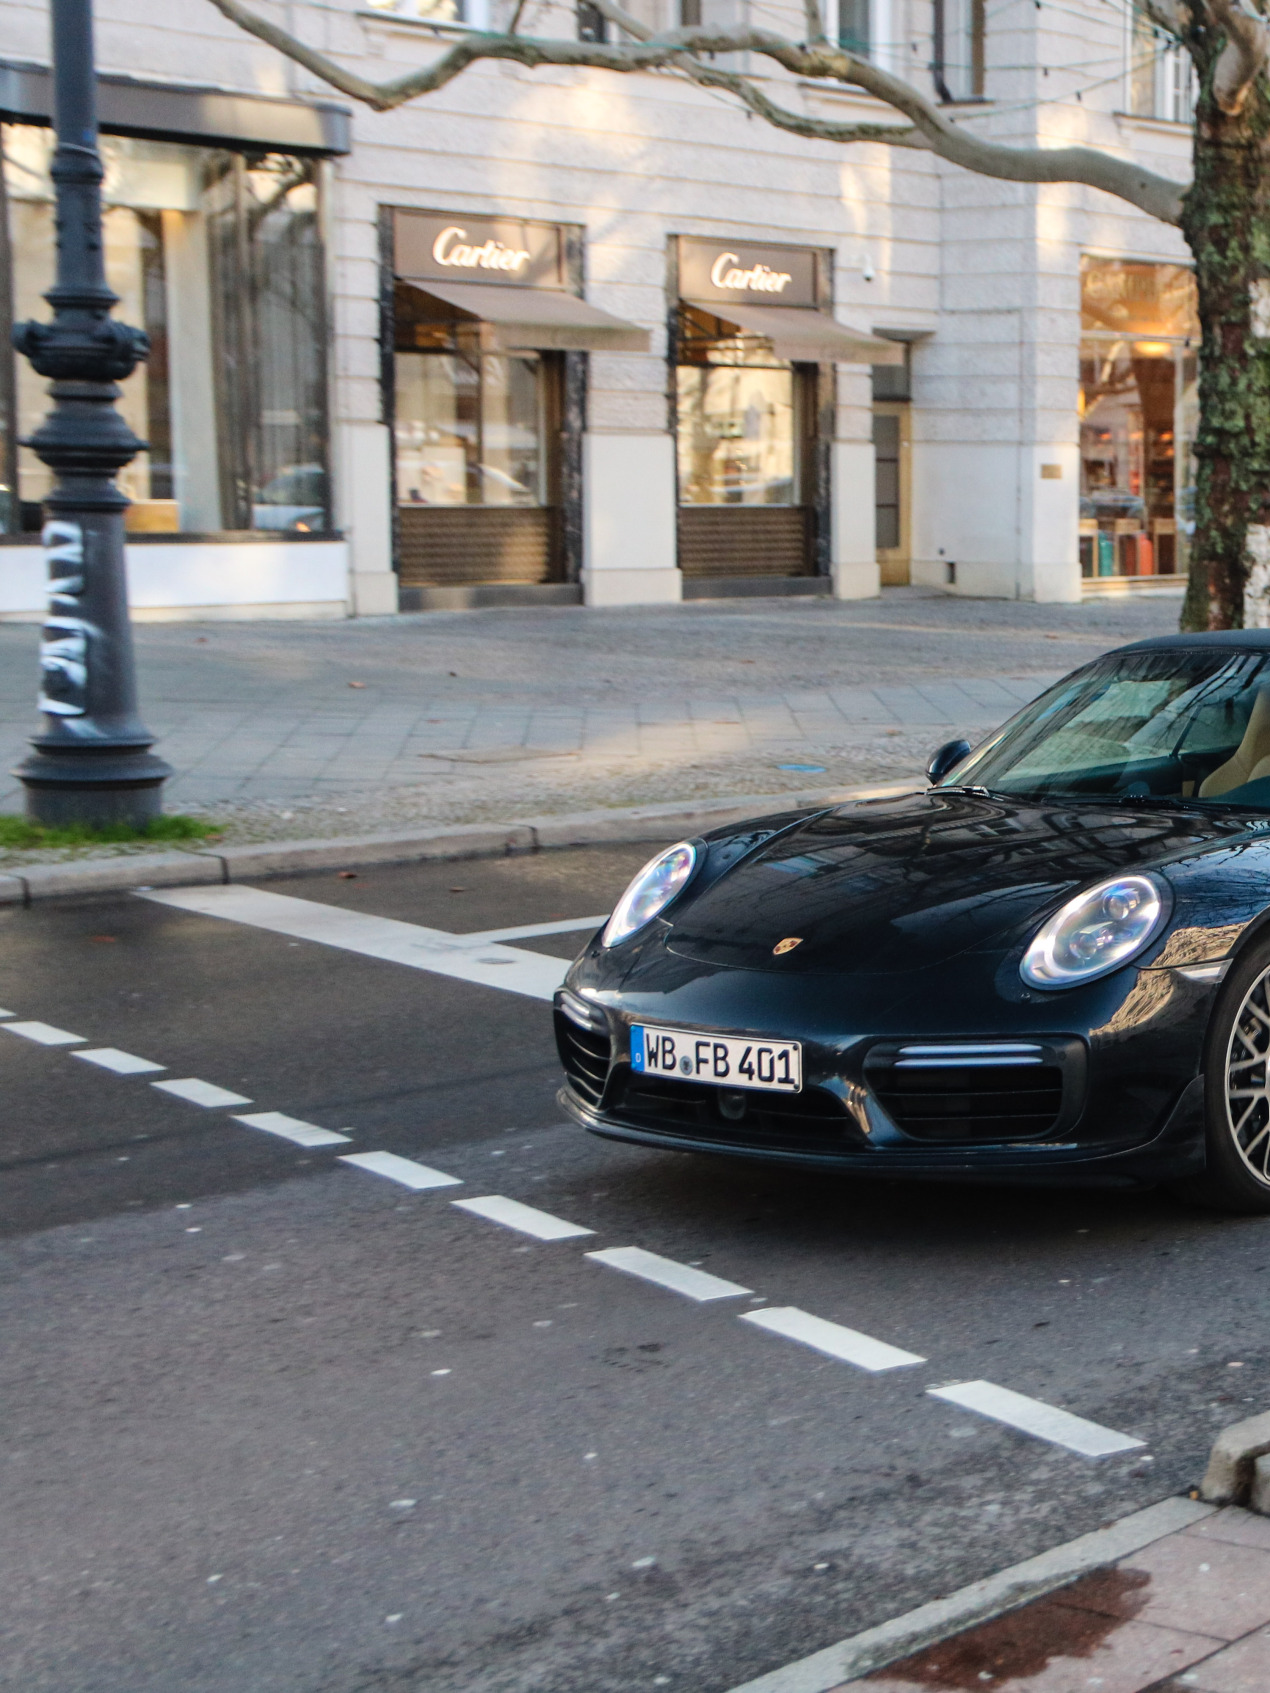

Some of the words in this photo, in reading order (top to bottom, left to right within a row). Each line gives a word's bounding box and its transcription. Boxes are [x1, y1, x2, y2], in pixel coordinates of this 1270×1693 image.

[432, 226, 530, 270] Cartier
[711, 252, 792, 292] Cartier
[645, 1033, 677, 1070] WB
[695, 1041, 730, 1078] FB
[738, 1046, 795, 1084] 401
